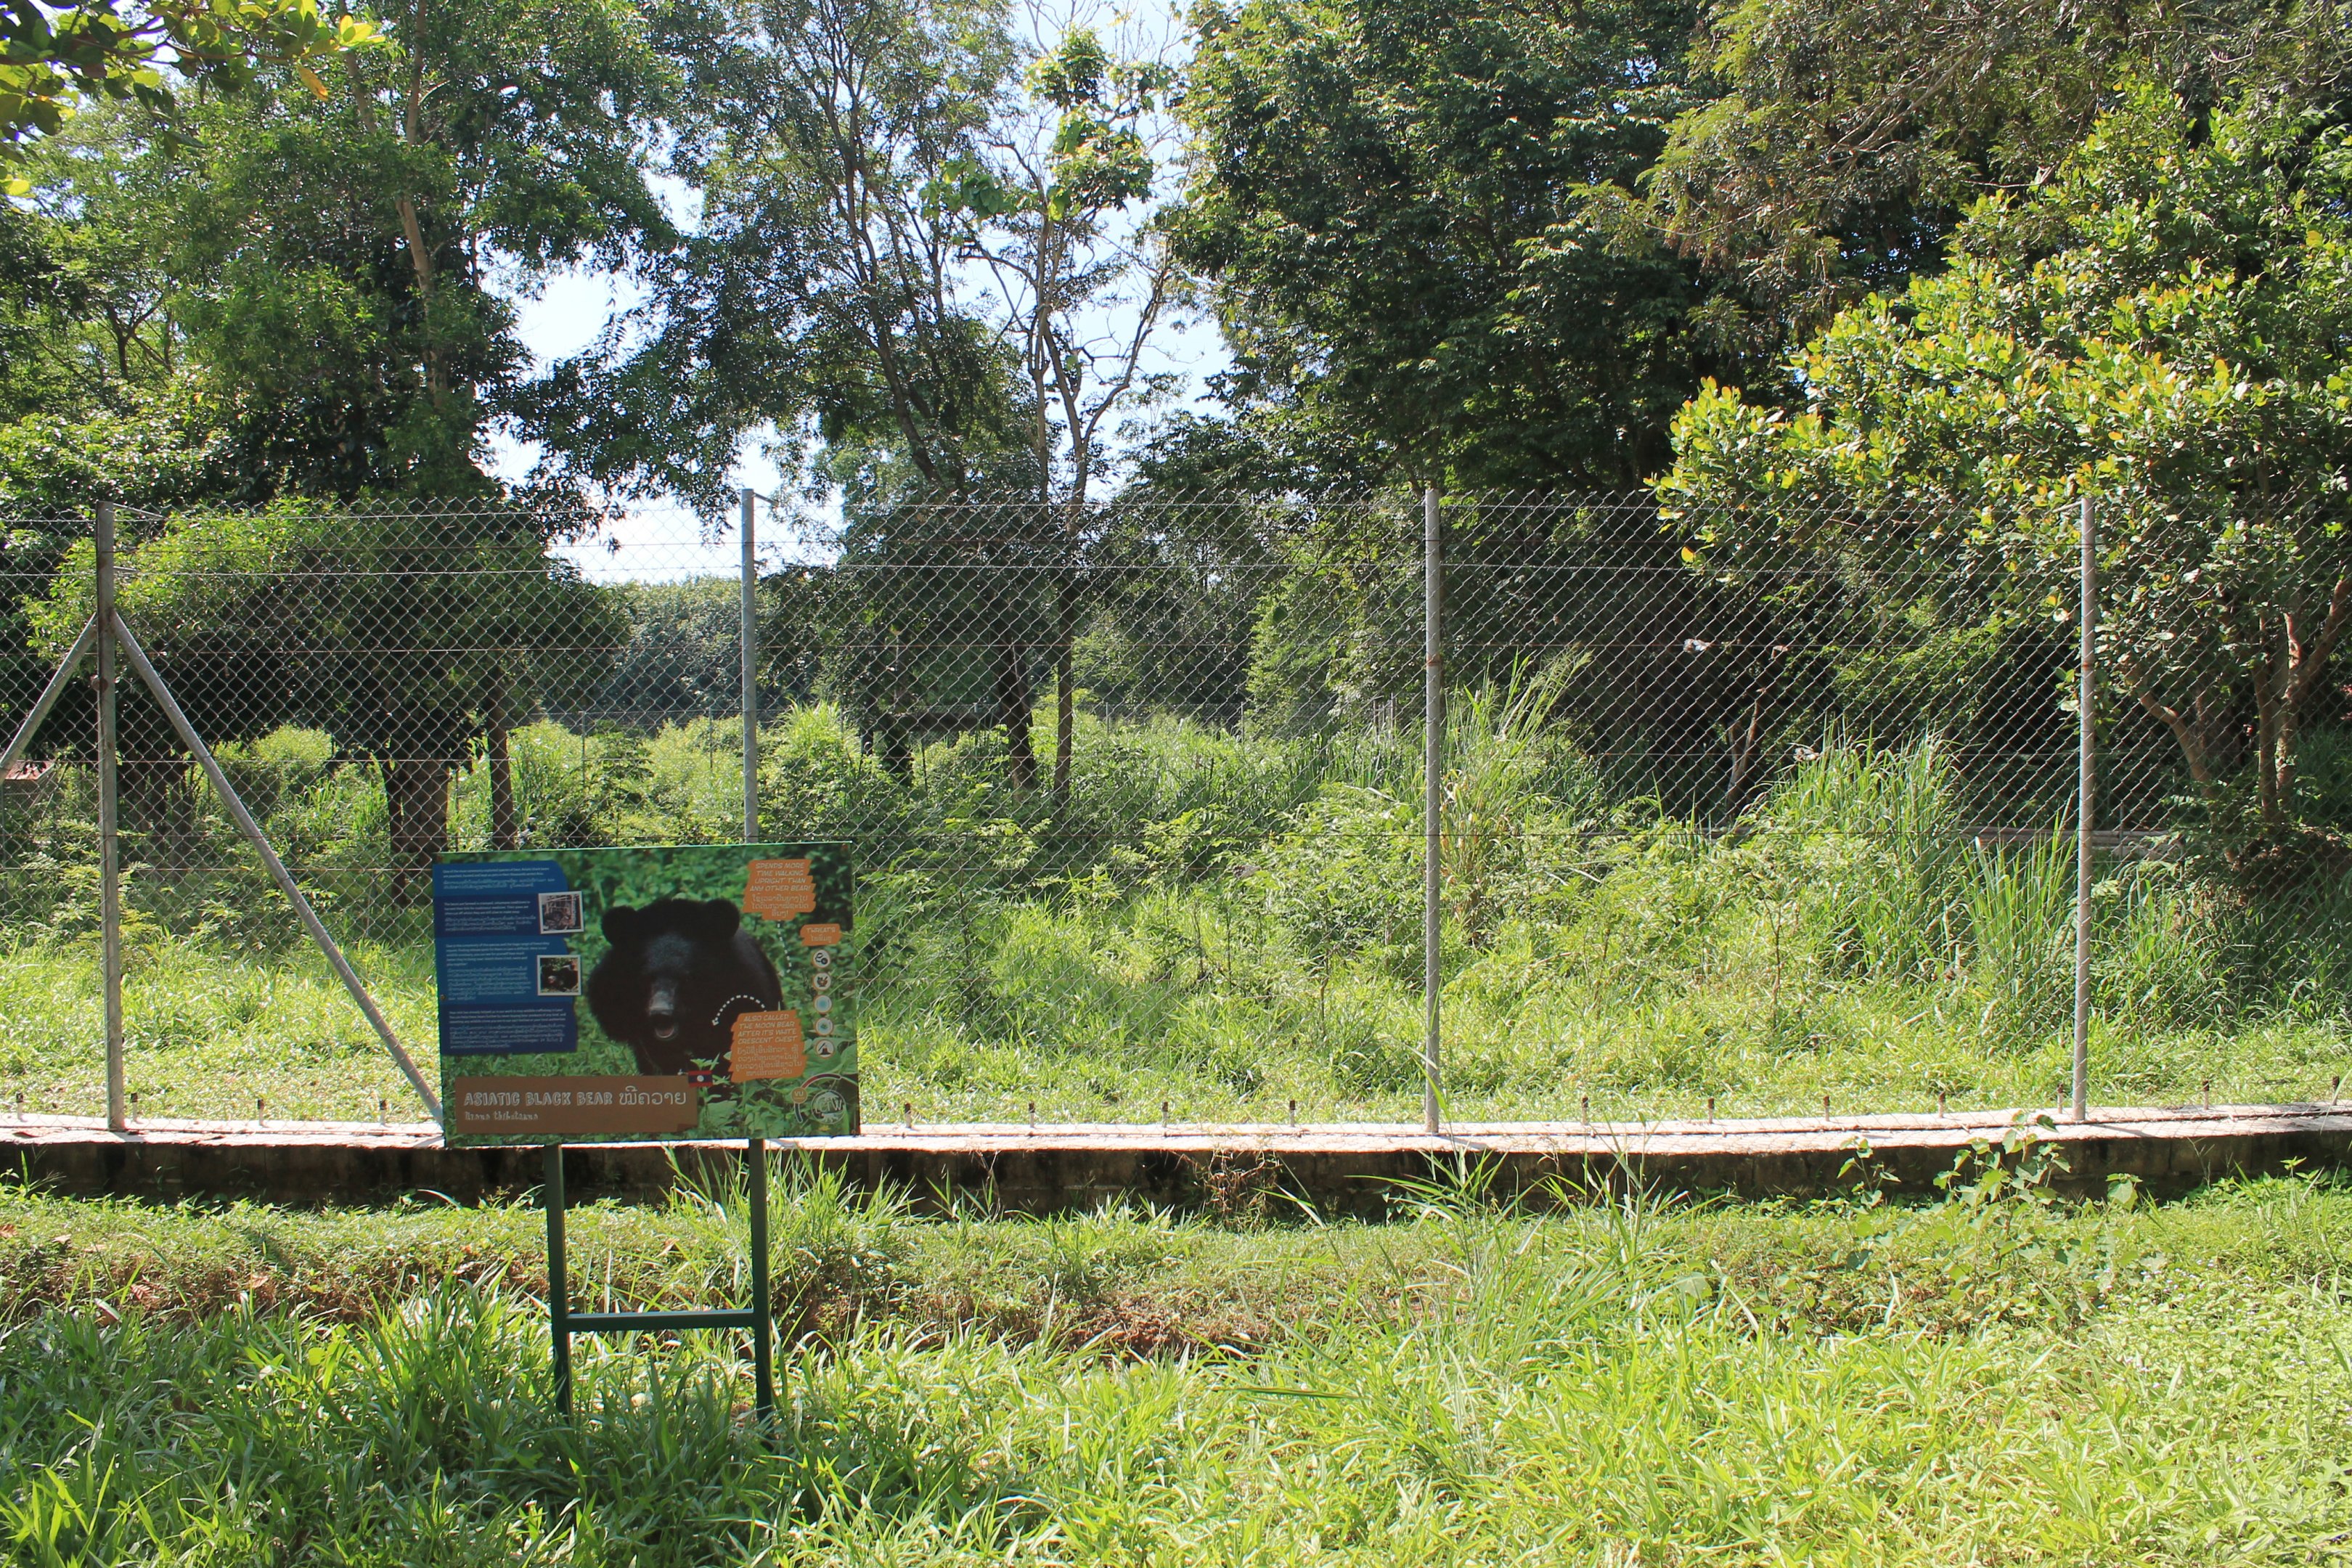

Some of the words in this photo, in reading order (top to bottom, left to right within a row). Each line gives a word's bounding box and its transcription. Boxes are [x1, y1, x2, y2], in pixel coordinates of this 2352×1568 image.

[464, 1092, 520, 1106] ASIATIC
[526, 1092, 571, 1106] BLACK
[576, 1092, 613, 1106] BEAR
